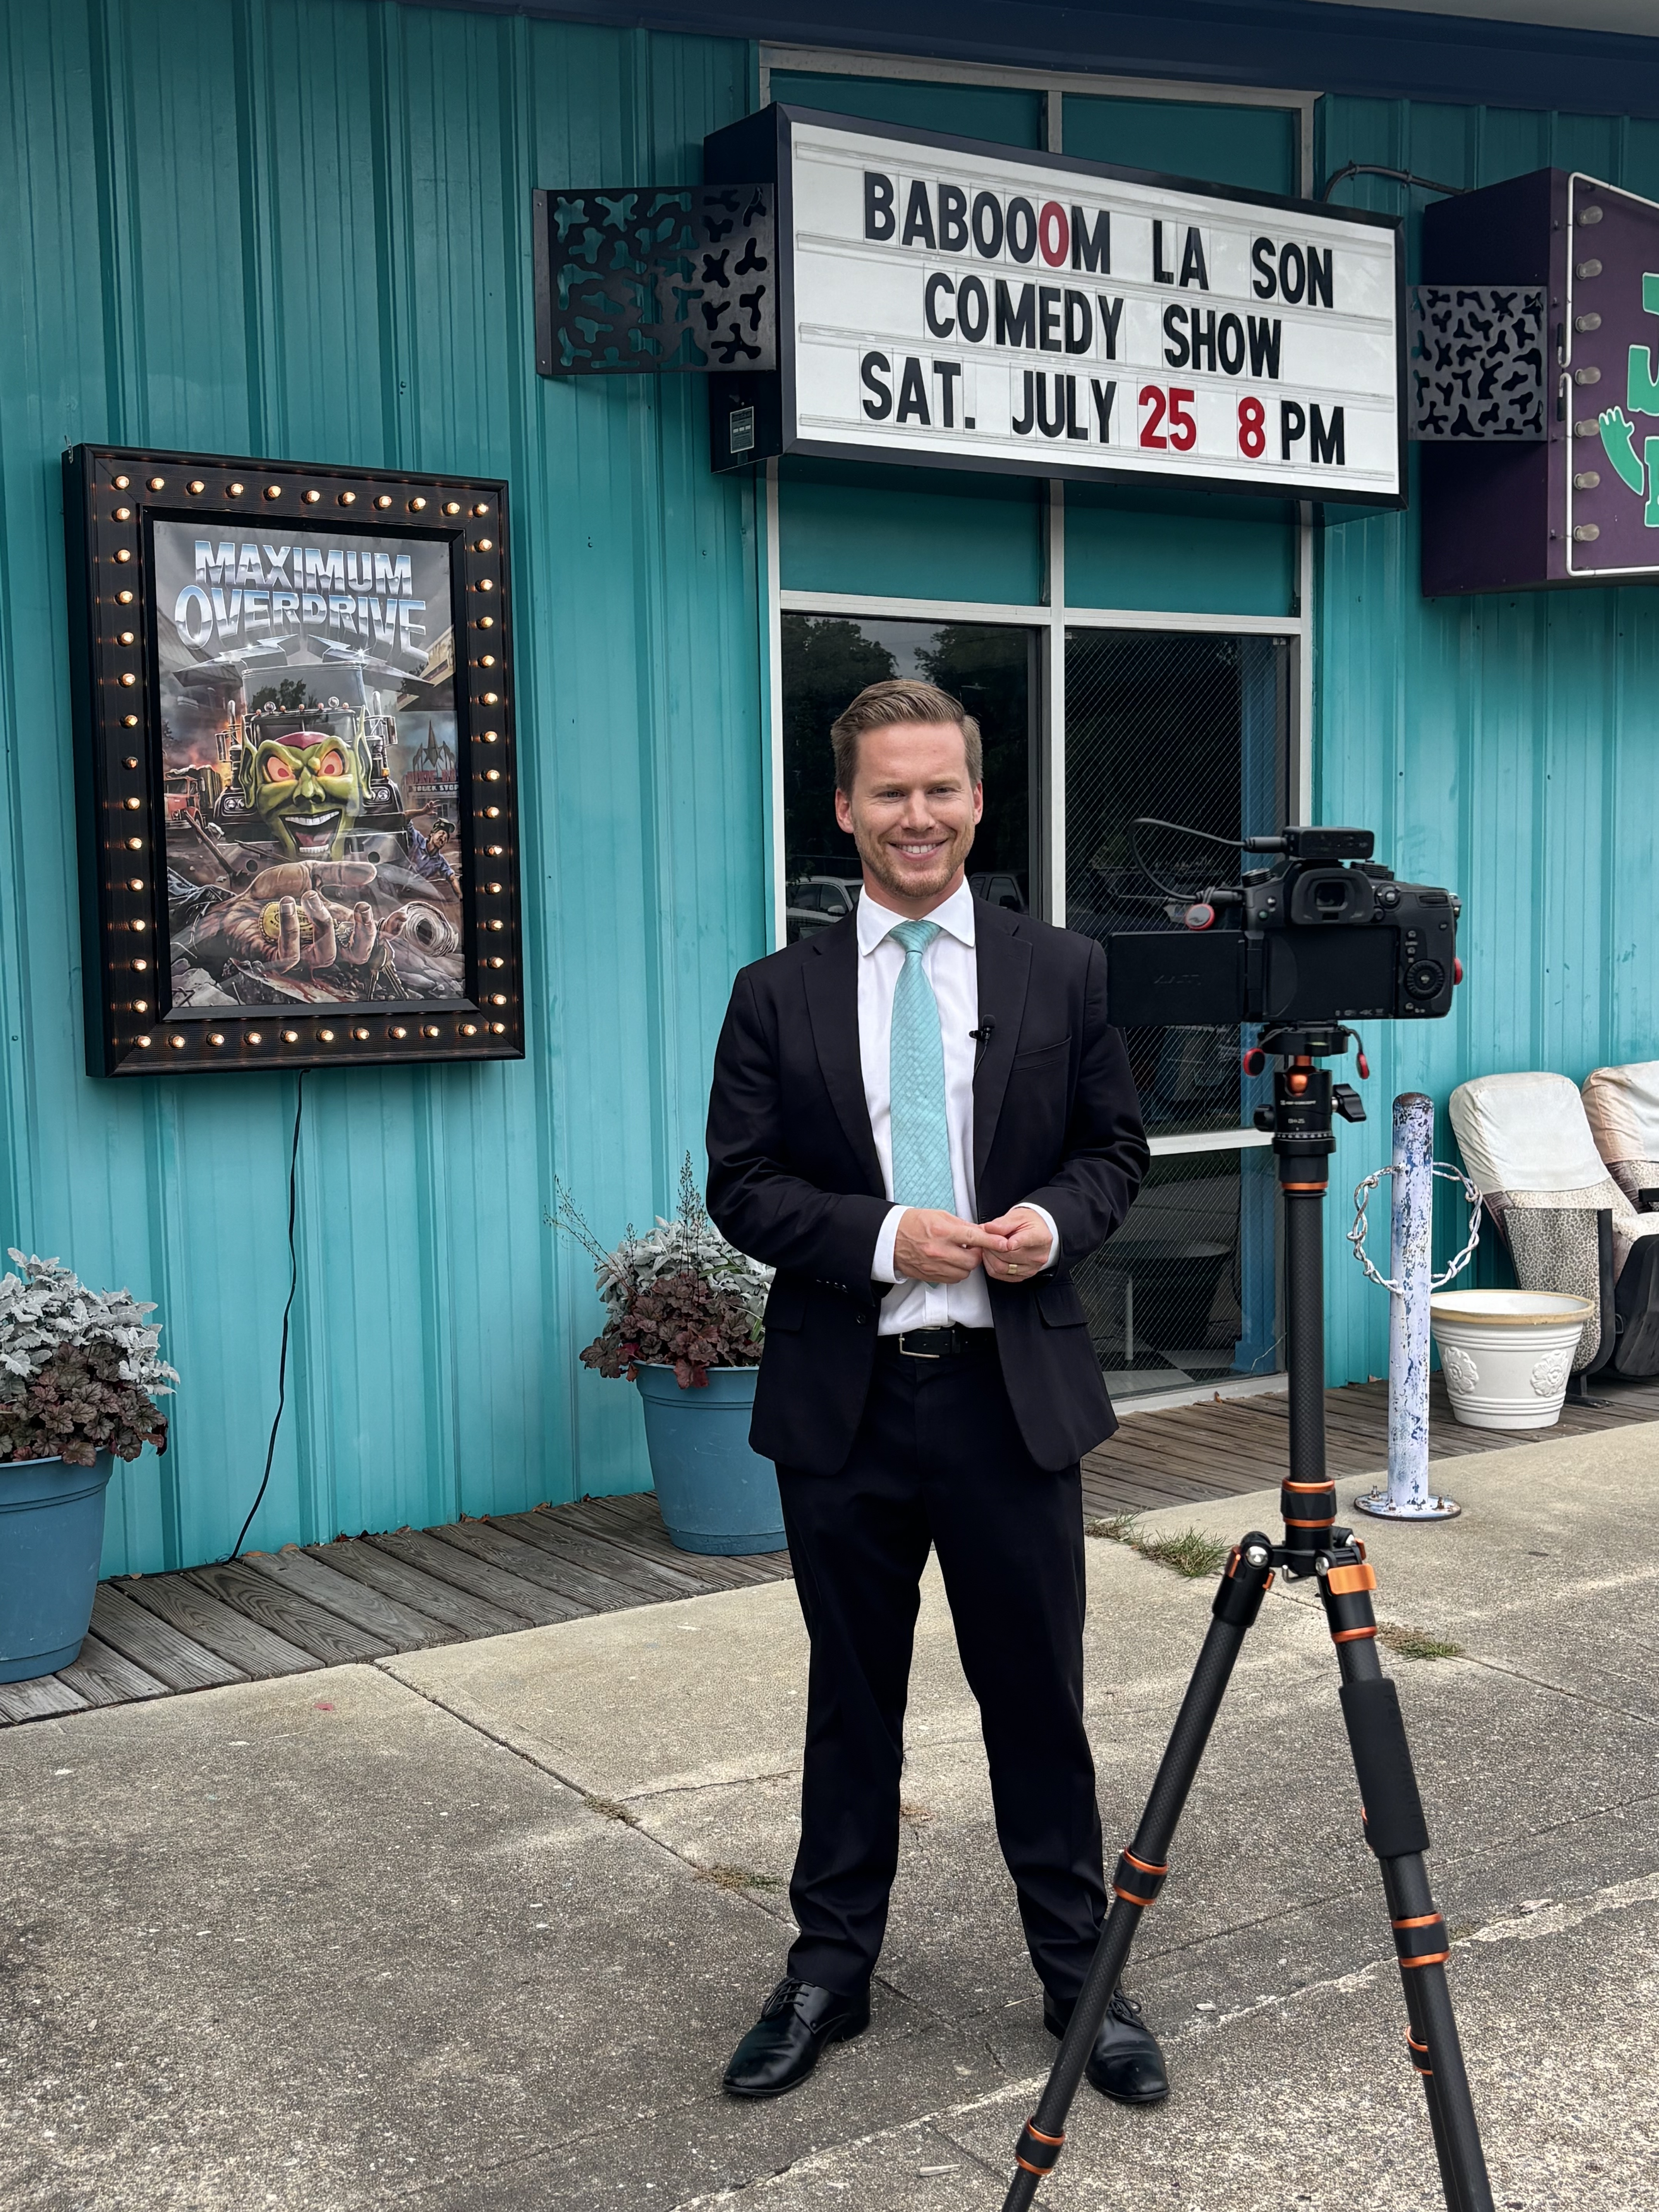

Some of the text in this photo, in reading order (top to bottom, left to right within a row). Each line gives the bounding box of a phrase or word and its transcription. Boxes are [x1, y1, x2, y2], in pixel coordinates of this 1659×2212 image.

[864, 171, 1333, 309] BABOOOM LA SON
[925, 272, 1281, 379] COMEDY SHOW
[861, 351, 1345, 465] SAT. JULY 25 8 PM
[195, 540, 412, 595] MAXIMUM
[174, 585, 429, 663] OVERDRIVE
